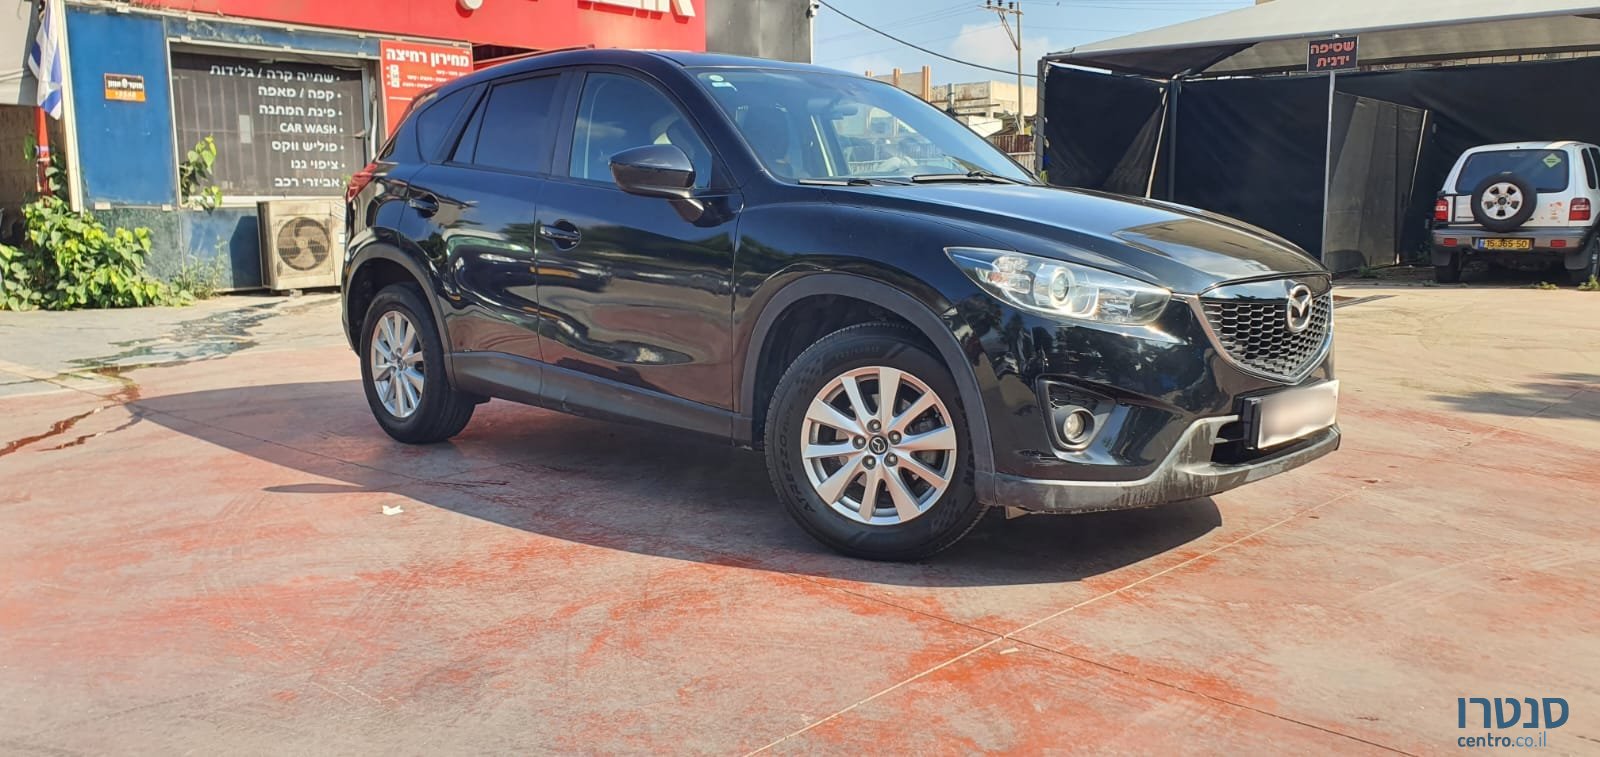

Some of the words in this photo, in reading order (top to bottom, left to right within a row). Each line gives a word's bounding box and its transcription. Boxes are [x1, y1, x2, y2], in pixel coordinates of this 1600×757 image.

[386, 48, 427, 63] רחיצה
[430, 52, 469, 67] מחירון
[1316, 55, 1350, 67] ידנית
[210, 64, 255, 78] גלידות
[266, 69, 293, 82] קרה
[297, 71, 334, 83] שתייה
[258, 86, 296, 98] מאפה
[307, 89, 334, 102] קפה
[259, 104, 304, 116] המתנה
[307, 107, 336, 118] פינת
[279, 122, 302, 133] CAR
[304, 123, 337, 134] WASH
[271, 140, 299, 153] ווקס
[302, 139, 338, 152] פוליש
[291, 159, 307, 169] ננו
[310, 159, 338, 169] ציפוי
[274, 176, 299, 187] רכב
[302, 177, 340, 187] אביזרי
